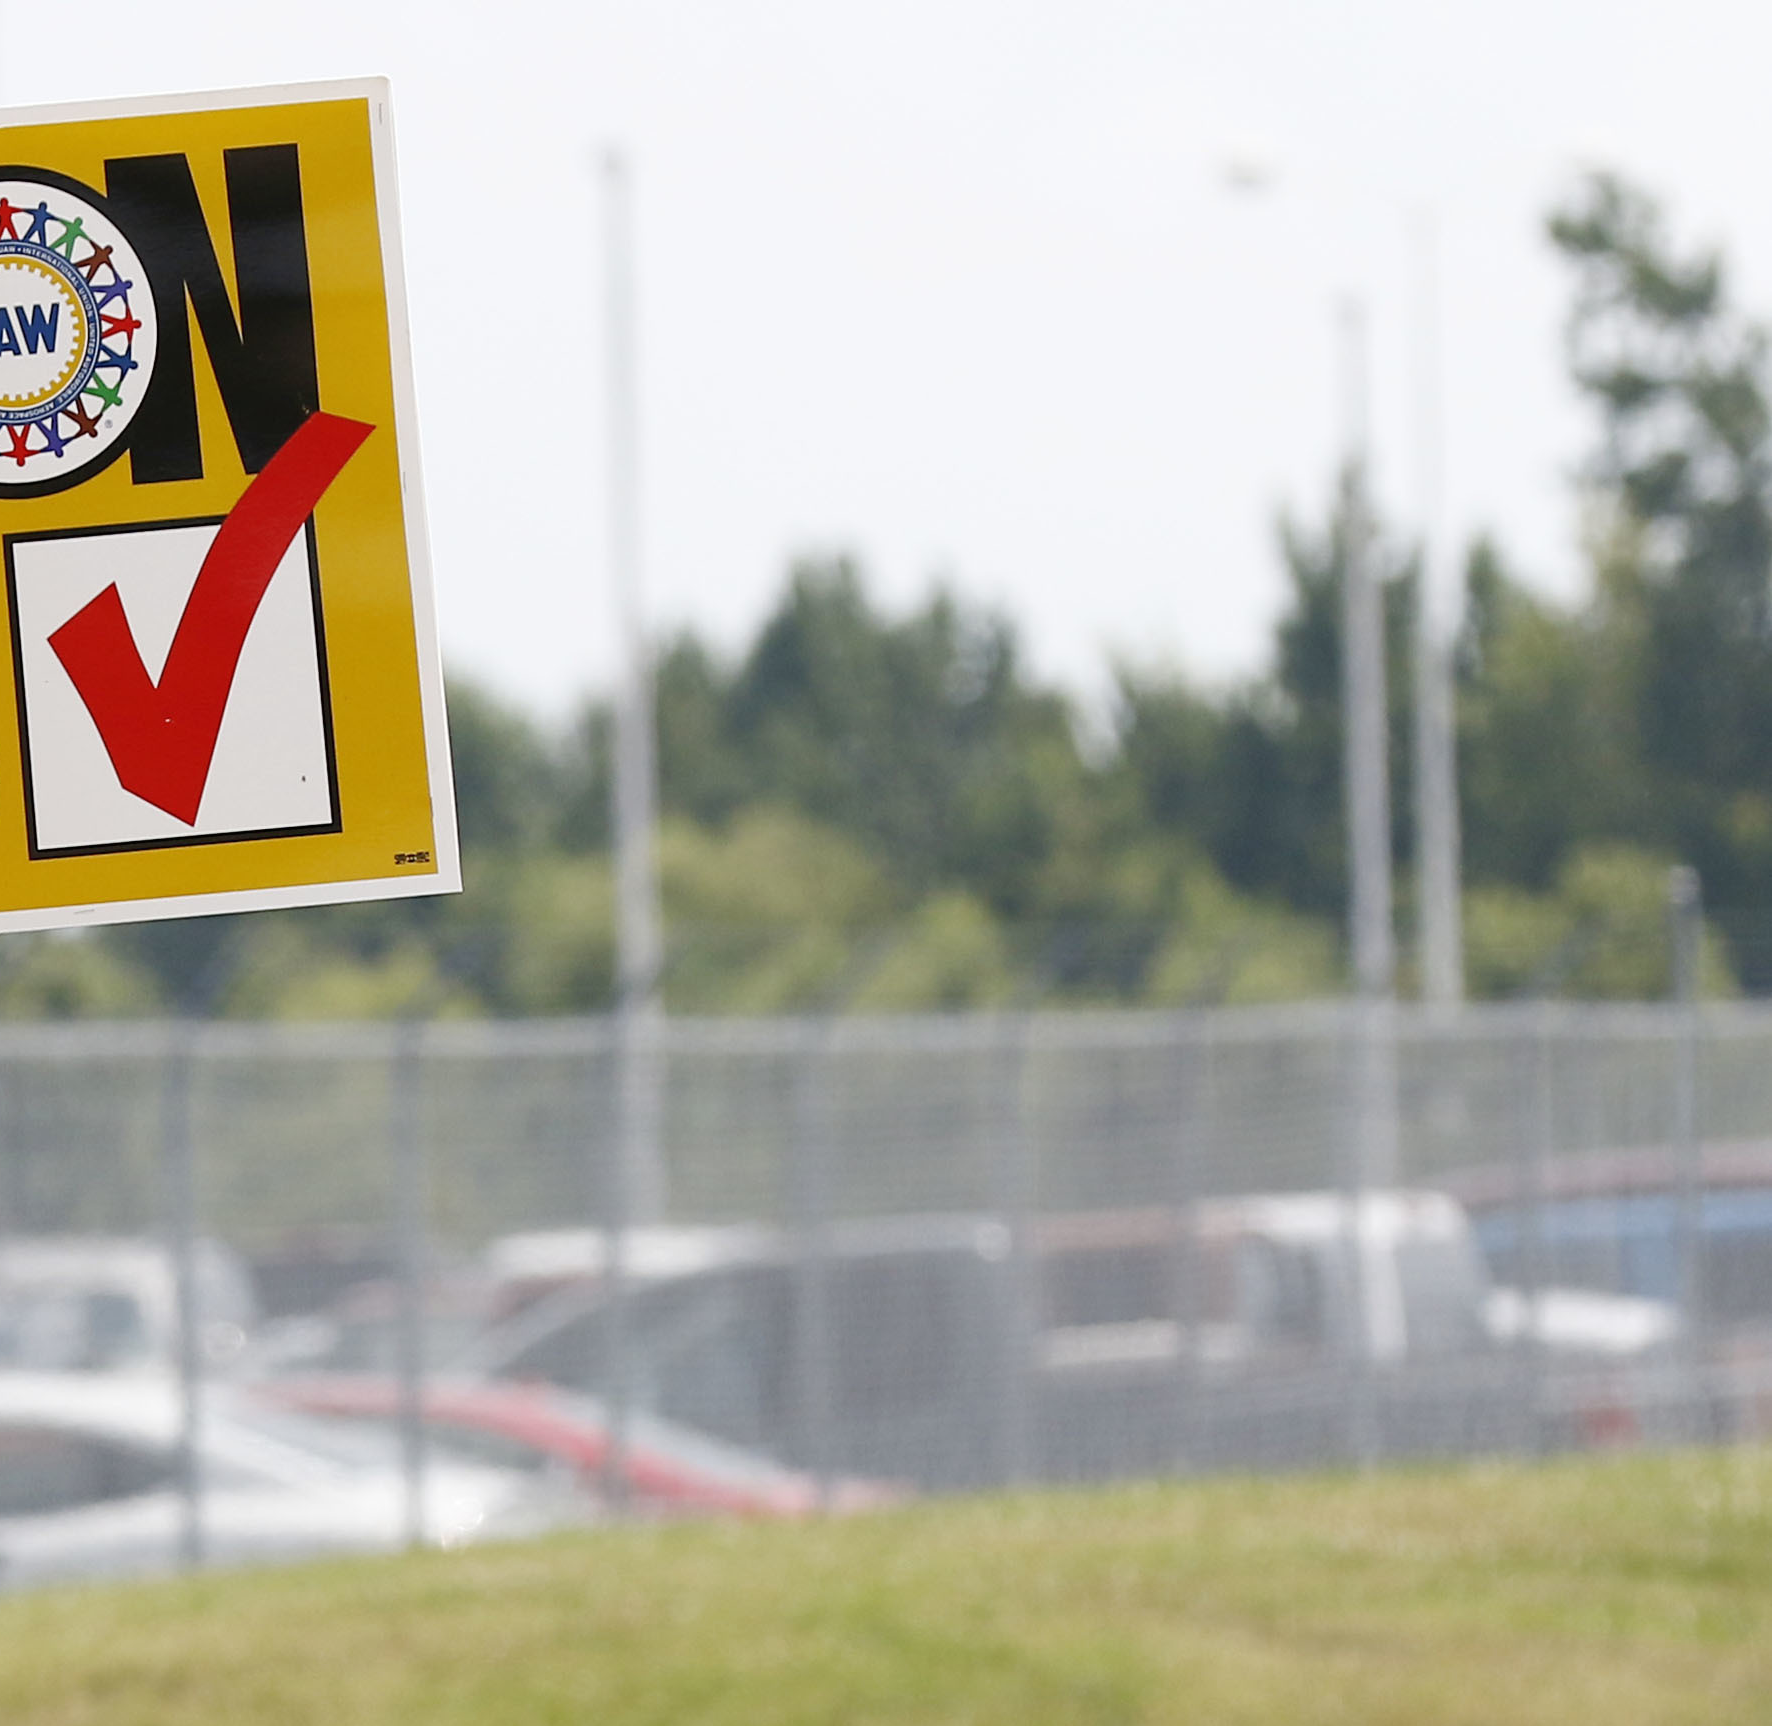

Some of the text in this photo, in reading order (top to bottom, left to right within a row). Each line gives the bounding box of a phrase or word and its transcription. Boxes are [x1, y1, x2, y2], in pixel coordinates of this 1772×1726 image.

[22, 247, 81, 286] INTERNATIONAL
[78, 287, 95, 316] UNION
[87, 322, 97, 354] UNITED
[56, 355, 93, 402] AUTOMOBILE
[9, 399, 55, 417] AEROSPACE
